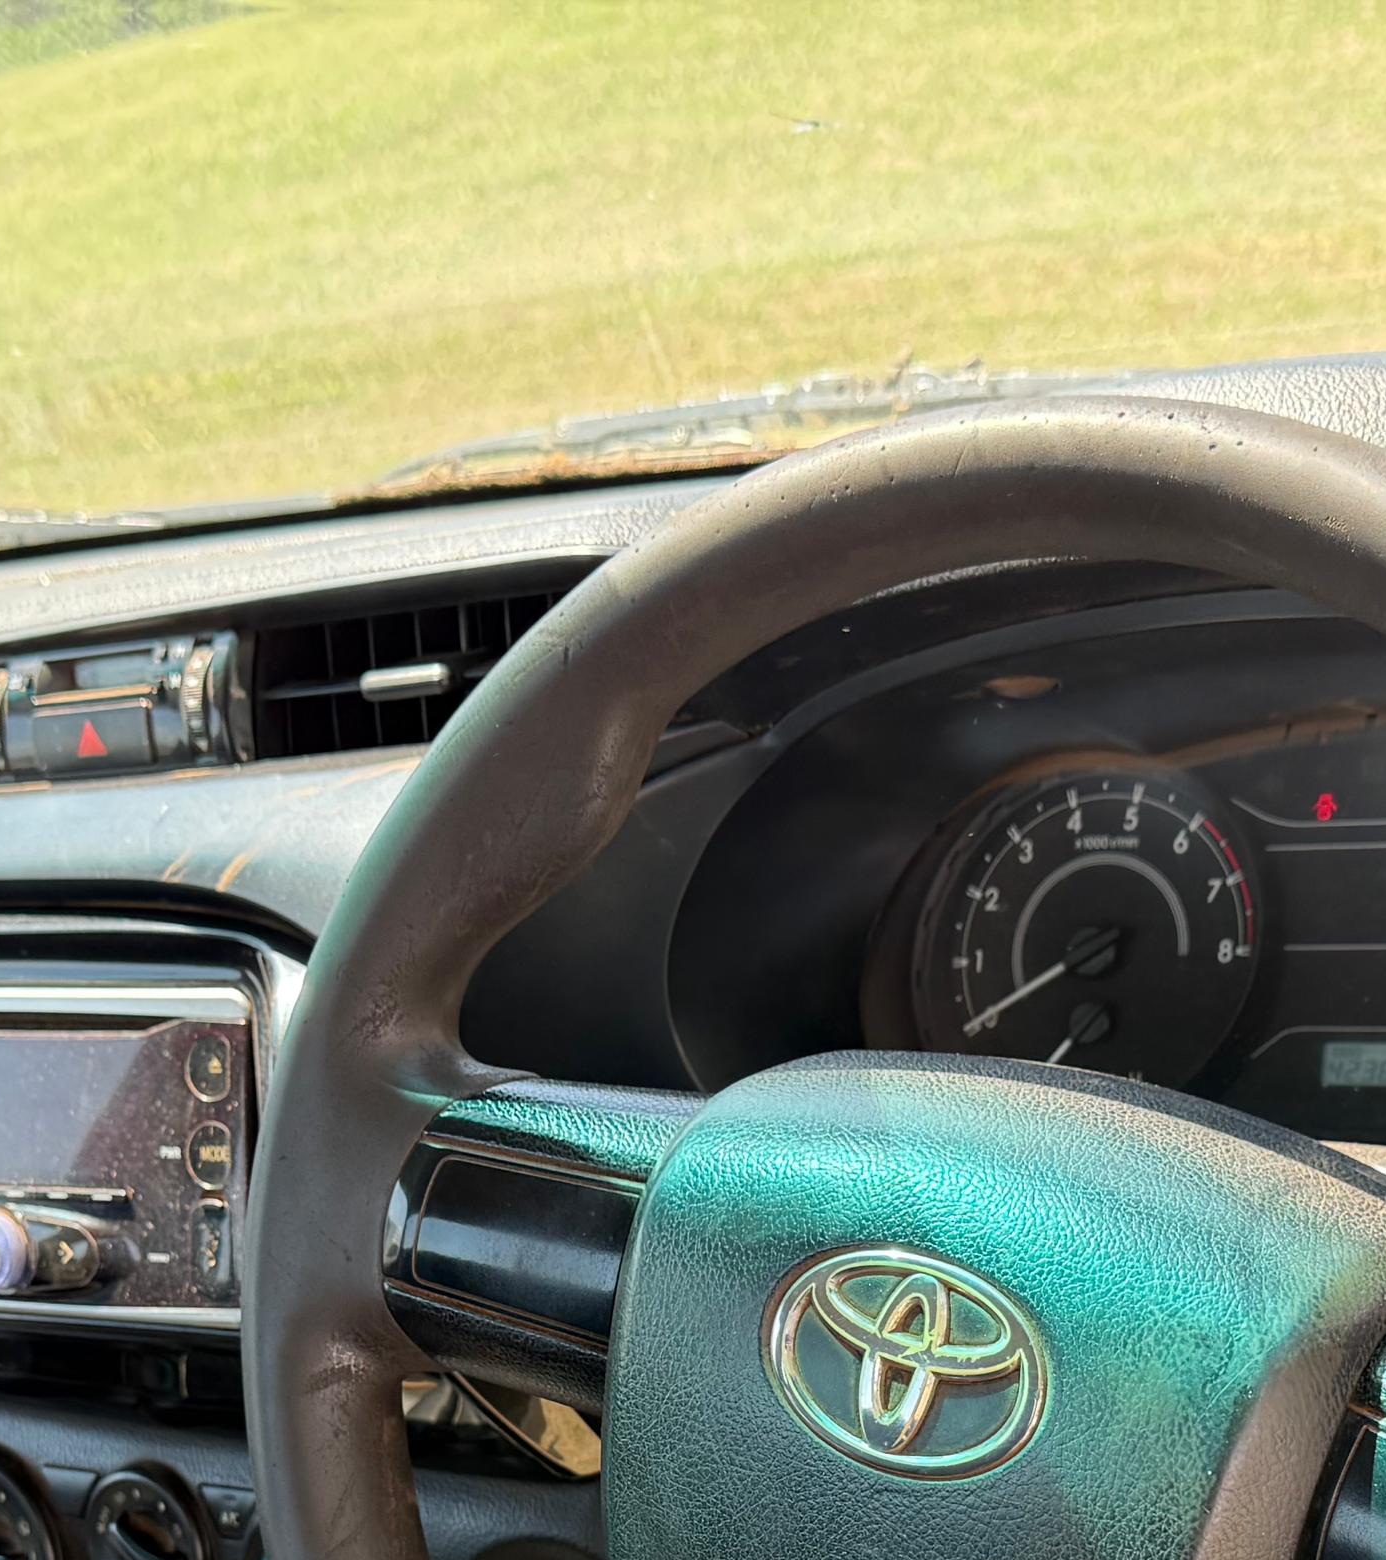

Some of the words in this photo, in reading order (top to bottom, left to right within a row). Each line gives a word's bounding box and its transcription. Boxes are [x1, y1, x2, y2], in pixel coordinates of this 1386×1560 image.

[1066, 810, 1083, 834] 4
[1123, 807, 1139, 831] 5
[1018, 839, 1034, 863] 3
[1173, 830, 1190, 854] 6
[984, 887, 1000, 911] 2
[1207, 878, 1223, 903] 7
[974, 949, 983, 973] 1
[1217, 938, 1234, 963] 8
[200, 1145, 231, 1162] MODE
